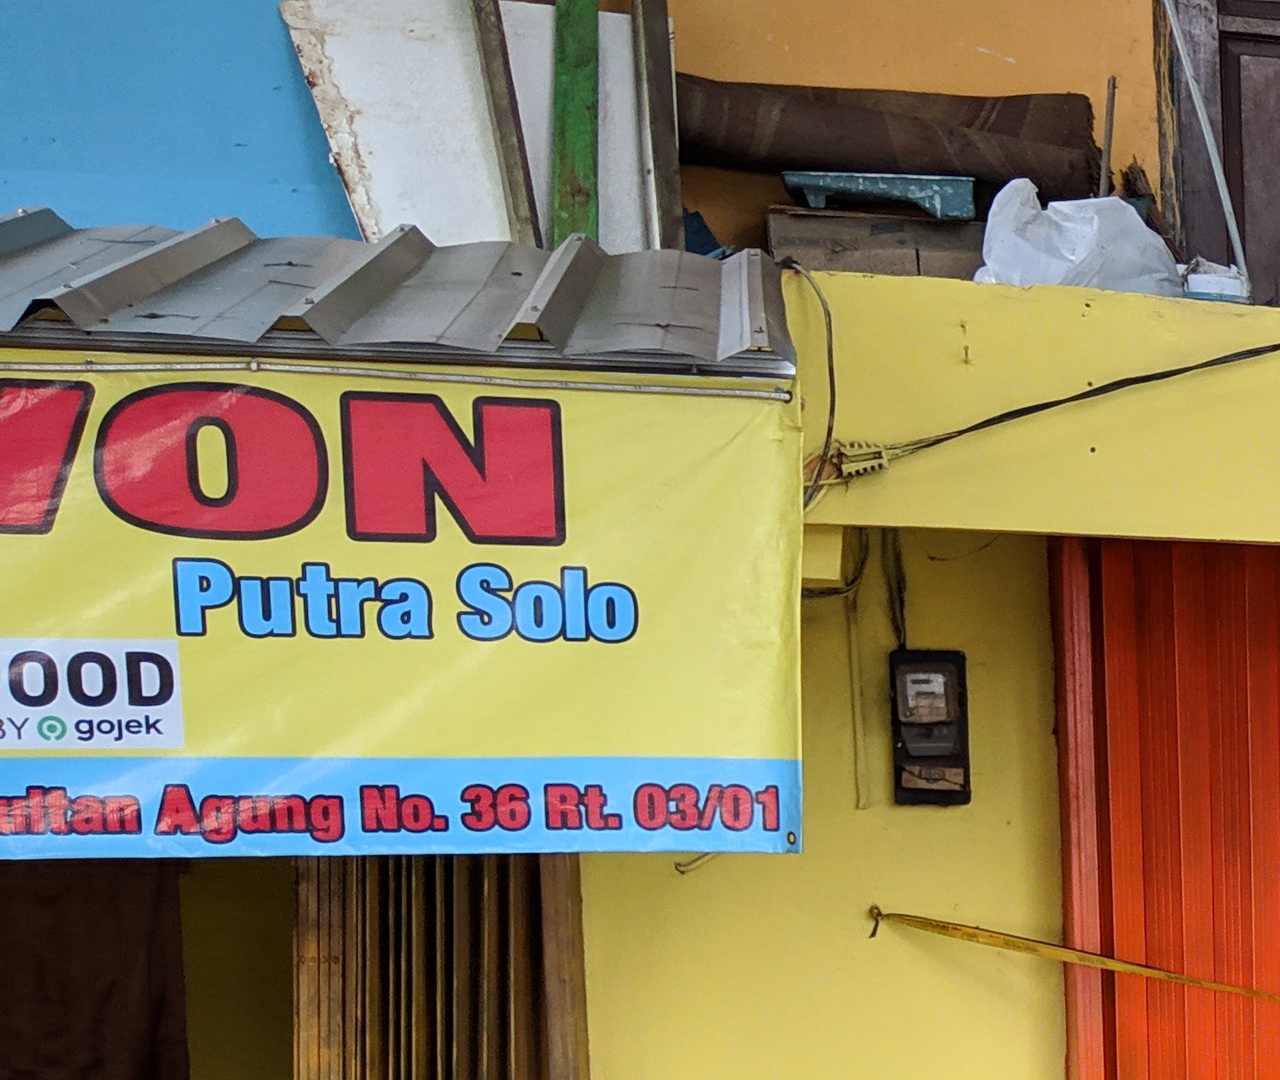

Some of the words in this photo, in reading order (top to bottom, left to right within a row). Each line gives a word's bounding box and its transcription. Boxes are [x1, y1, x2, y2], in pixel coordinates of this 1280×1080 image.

[173, 557, 432, 641] Putra
[456, 562, 639, 643] Solo
[74, 715, 164, 742] gojek
[154, 783, 345, 844] Agung
[360, 784, 449, 832] No.
[460, 784, 531, 831] 36
[544, 783, 622, 831] Rt.
[633, 784, 780, 831] 03/01
